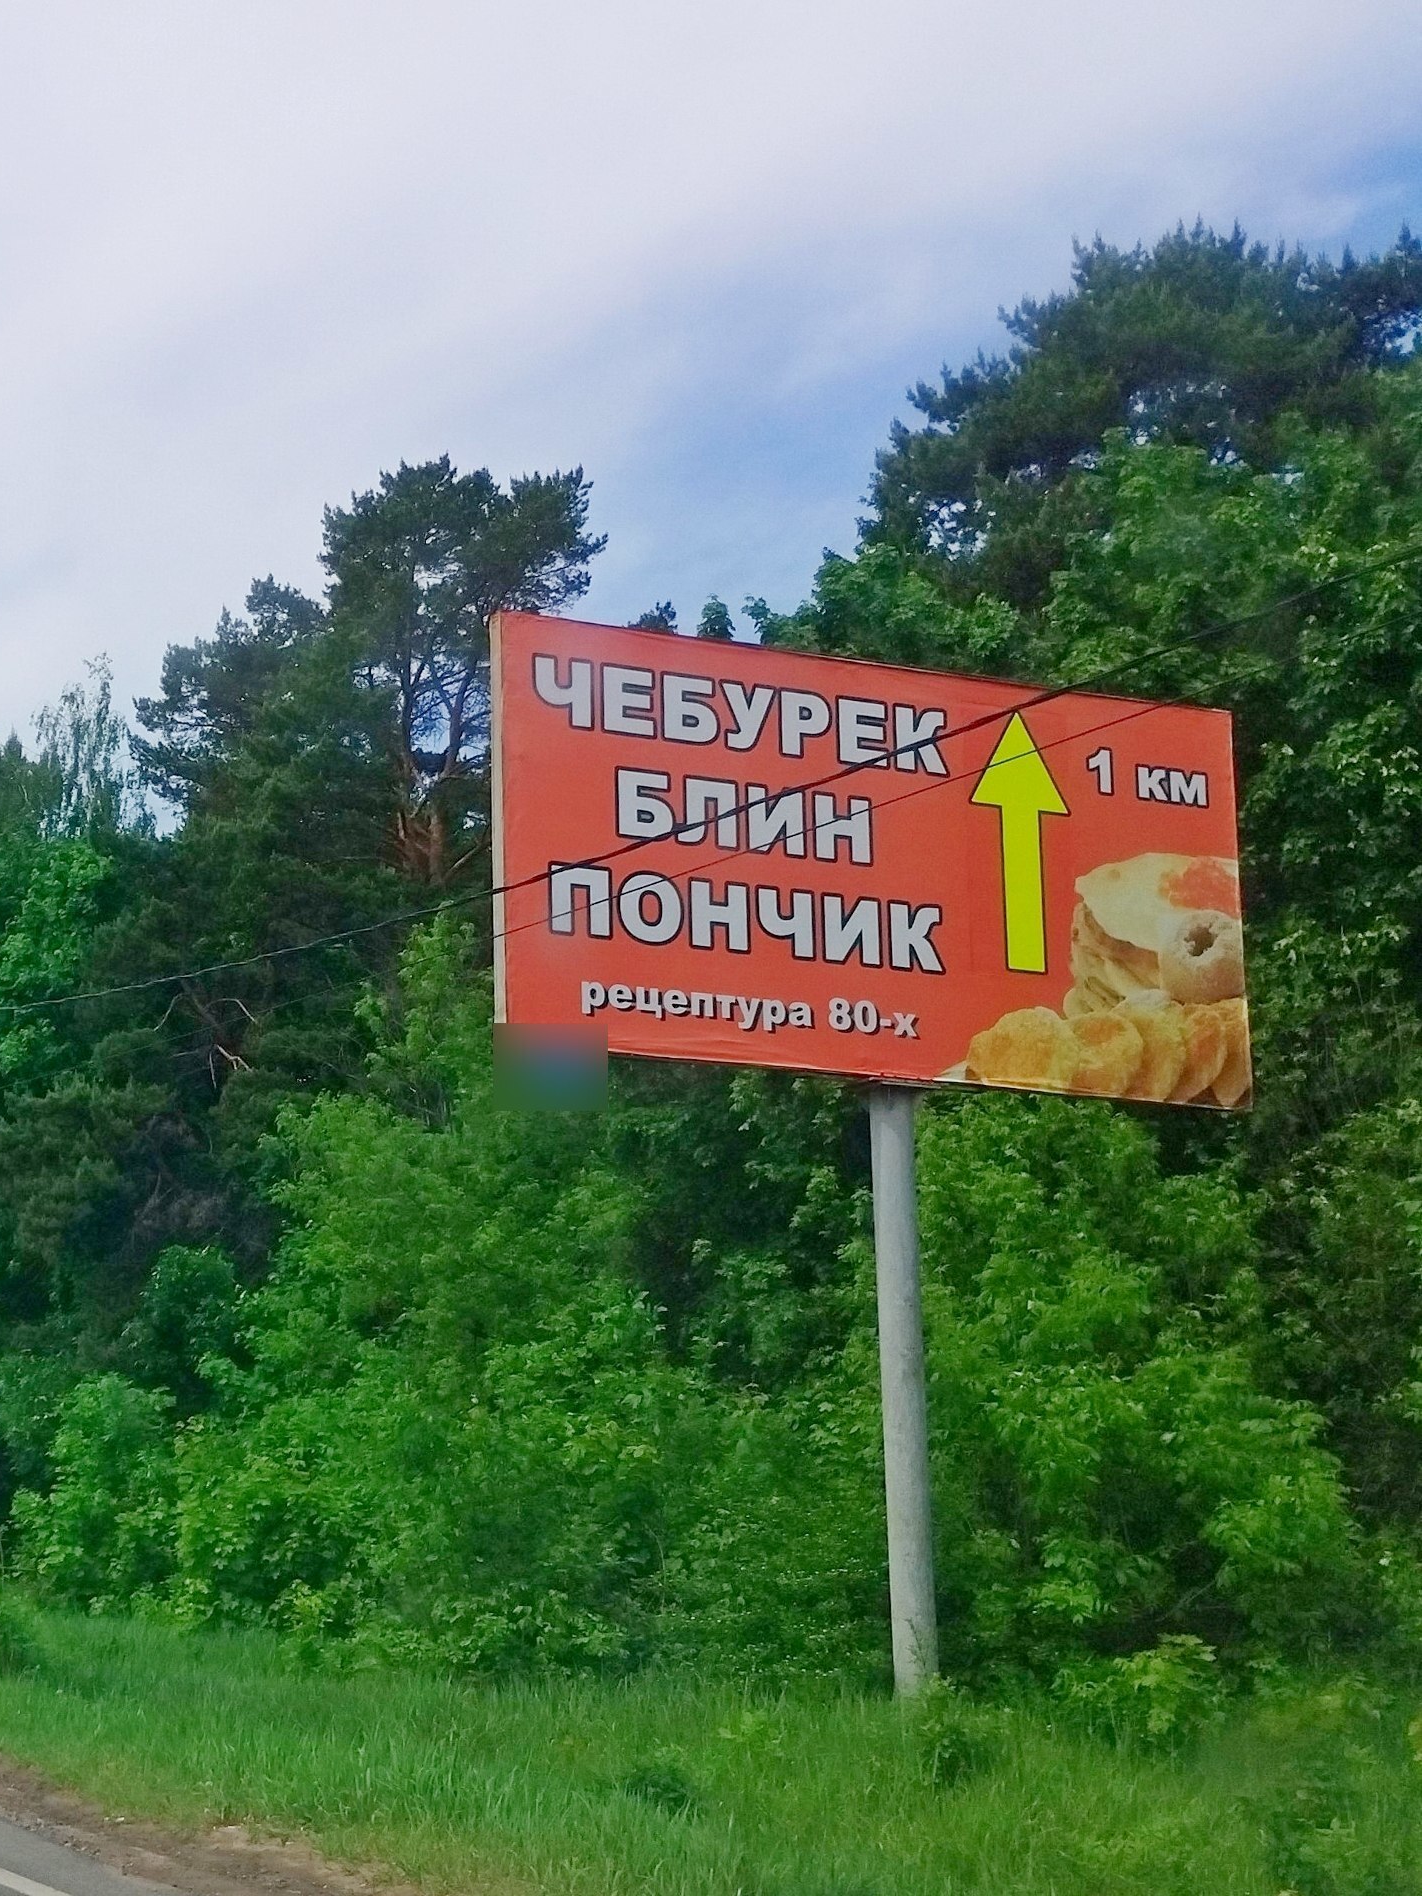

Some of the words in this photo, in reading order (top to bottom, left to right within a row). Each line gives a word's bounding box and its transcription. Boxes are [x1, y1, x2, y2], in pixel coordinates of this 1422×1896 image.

[532, 653, 950, 777] ЧЕБУРЕК
[615, 766, 873, 867] БЛИН
[1086, 746, 1114, 796] 1
[548, 861, 946, 975] ПОНЧИК
[581, 981, 814, 1032] рецептура
[828, 997, 920, 1039] 80-х
